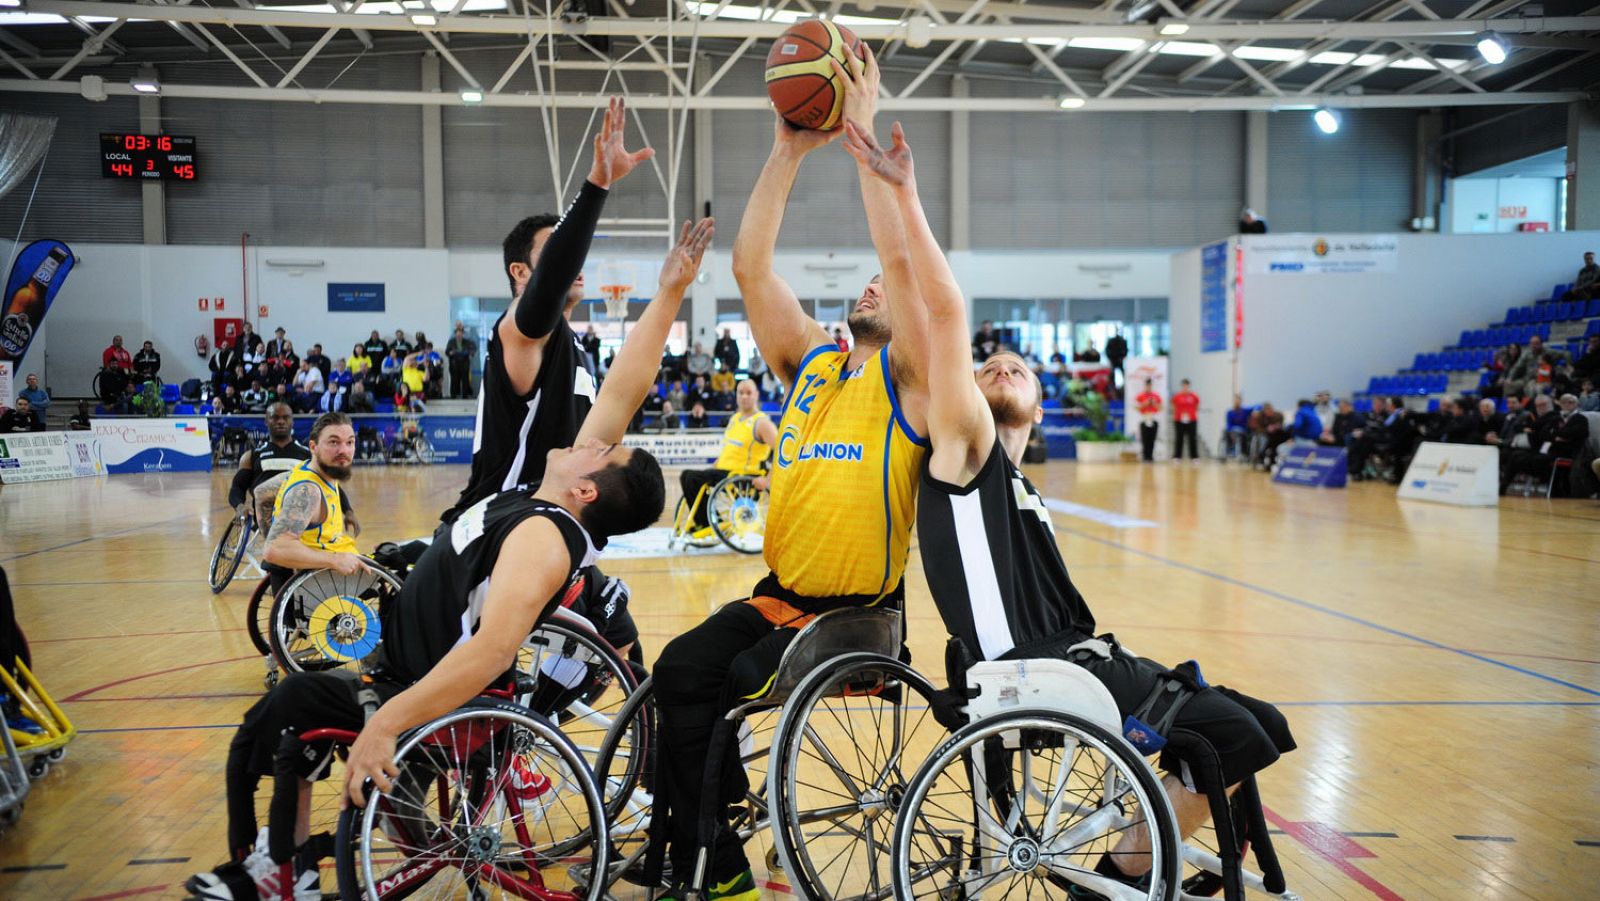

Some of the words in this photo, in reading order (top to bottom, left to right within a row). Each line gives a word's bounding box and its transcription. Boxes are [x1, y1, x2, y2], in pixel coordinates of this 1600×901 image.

[125, 135, 172, 151] 03:16
[105, 153, 132, 161] LOCAL
[111, 163, 133, 176] 44
[147, 160, 155, 171] 3
[173, 164, 195, 179] 45
